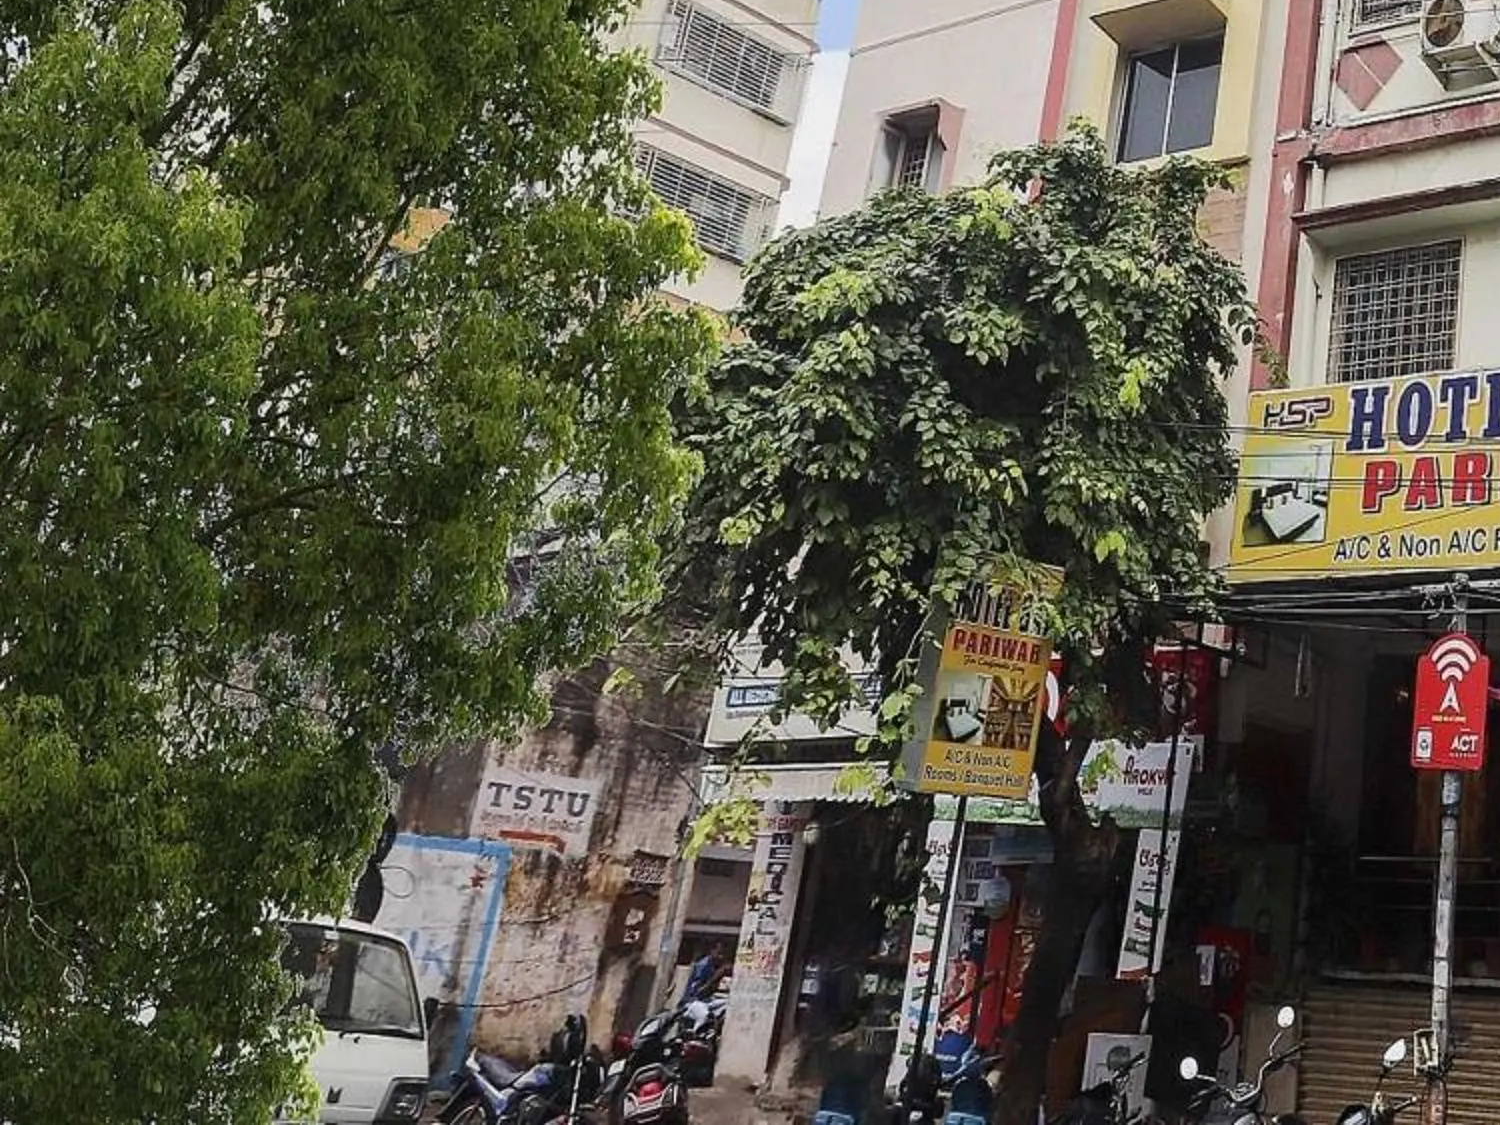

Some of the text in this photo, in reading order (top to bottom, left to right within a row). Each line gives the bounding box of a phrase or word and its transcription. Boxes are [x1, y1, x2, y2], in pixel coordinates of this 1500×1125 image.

[1334, 536, 1371, 561] A/C
[1377, 534, 1391, 559] &
[1399, 534, 1441, 557] Non
[1447, 528, 1487, 554] A/C
[1451, 734, 1479, 752] ACT
[1121, 755, 1175, 787] AROKY
[487, 781, 591, 817] TSTU
